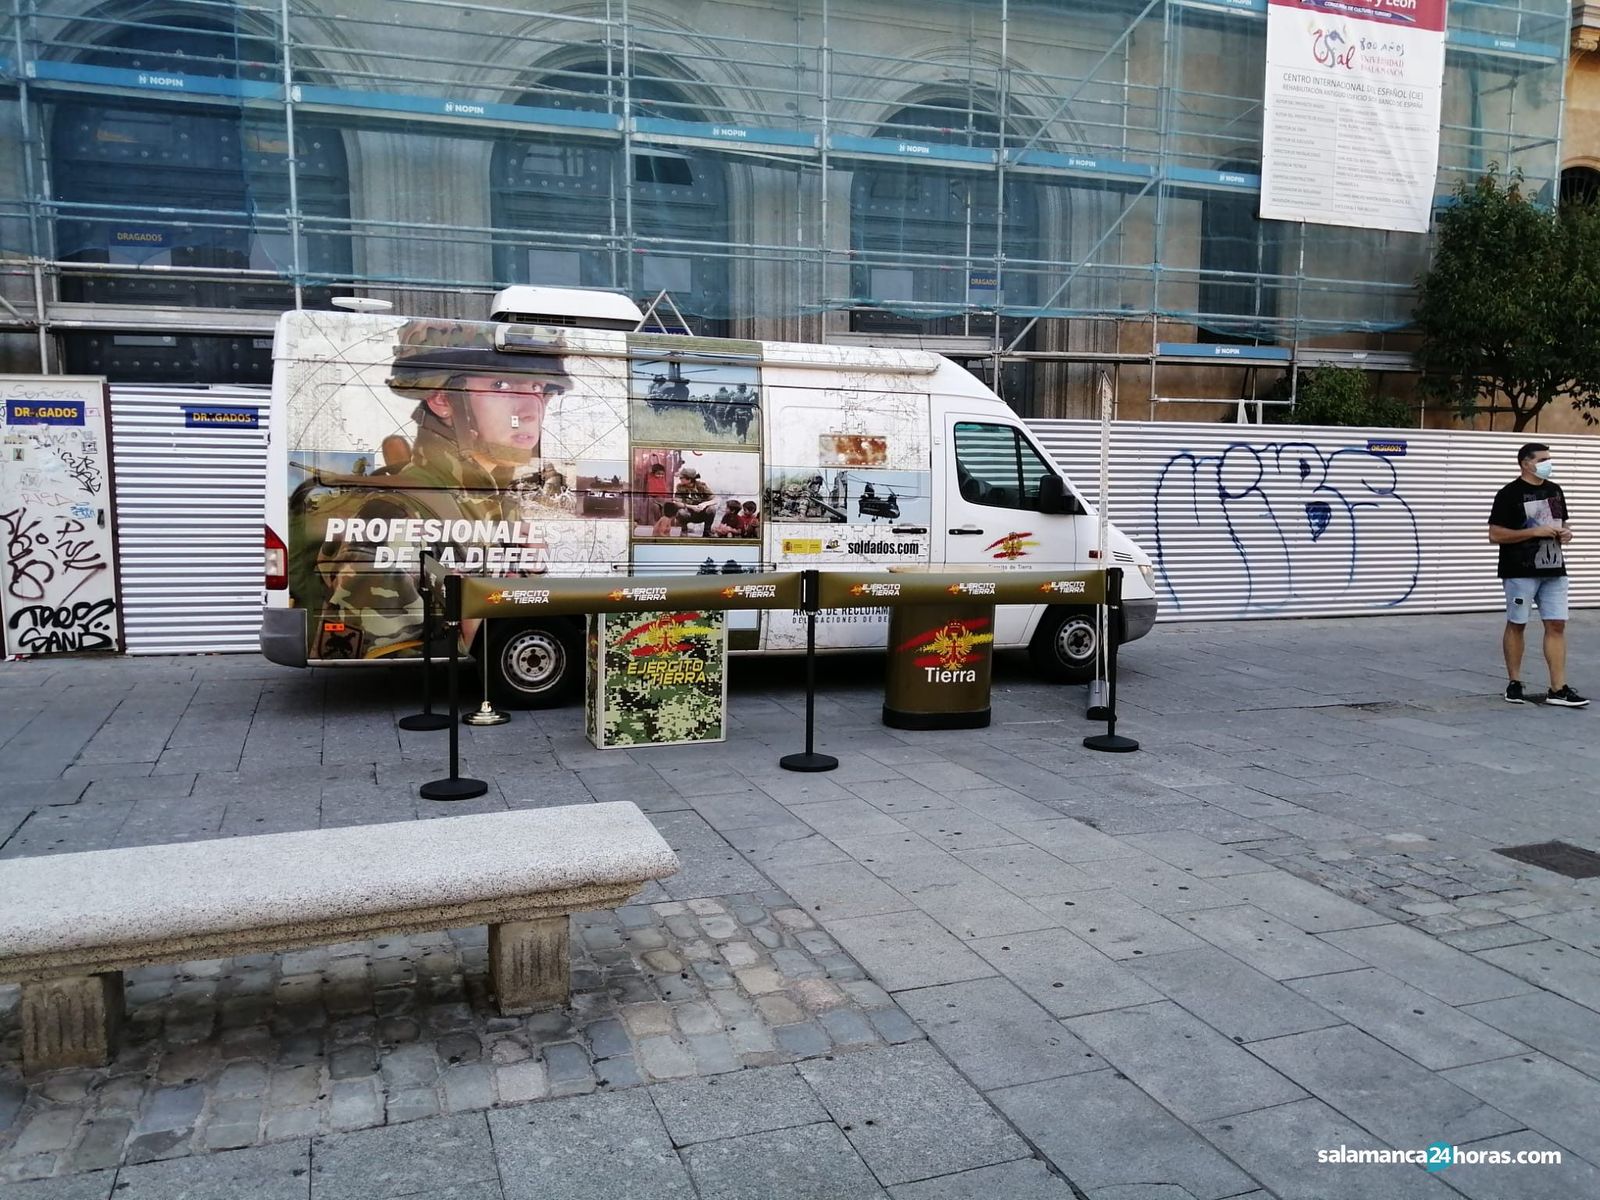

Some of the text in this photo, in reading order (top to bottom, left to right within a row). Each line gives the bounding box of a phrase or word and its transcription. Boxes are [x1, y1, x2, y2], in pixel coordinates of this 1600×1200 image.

[149, 78, 184, 88] NOPIN
[1283, 72, 1312, 84] CENTRO
[455, 104, 484, 114] NOPIN
[720, 128, 746, 138] NOPIN
[906, 145, 929, 154] NOPIN
[1075, 158, 1096, 168] NOPIN
[117, 231, 162, 242] DRAGADOS
[971, 277, 998, 286] DRAGADO
[14, 407, 78, 418] DRGADOS
[192, 412, 251, 423] DRGADOS
[324, 517, 563, 544] PROFESIONALES
[848, 540, 918, 555] soldados.com
[373, 546, 414, 569] DE
[464, 546, 591, 570] DEFENSA
[792, 616, 857, 624] DELGACIONES
[650, 671, 706, 685] TIERRA
[924, 666, 976, 683] Tierra
